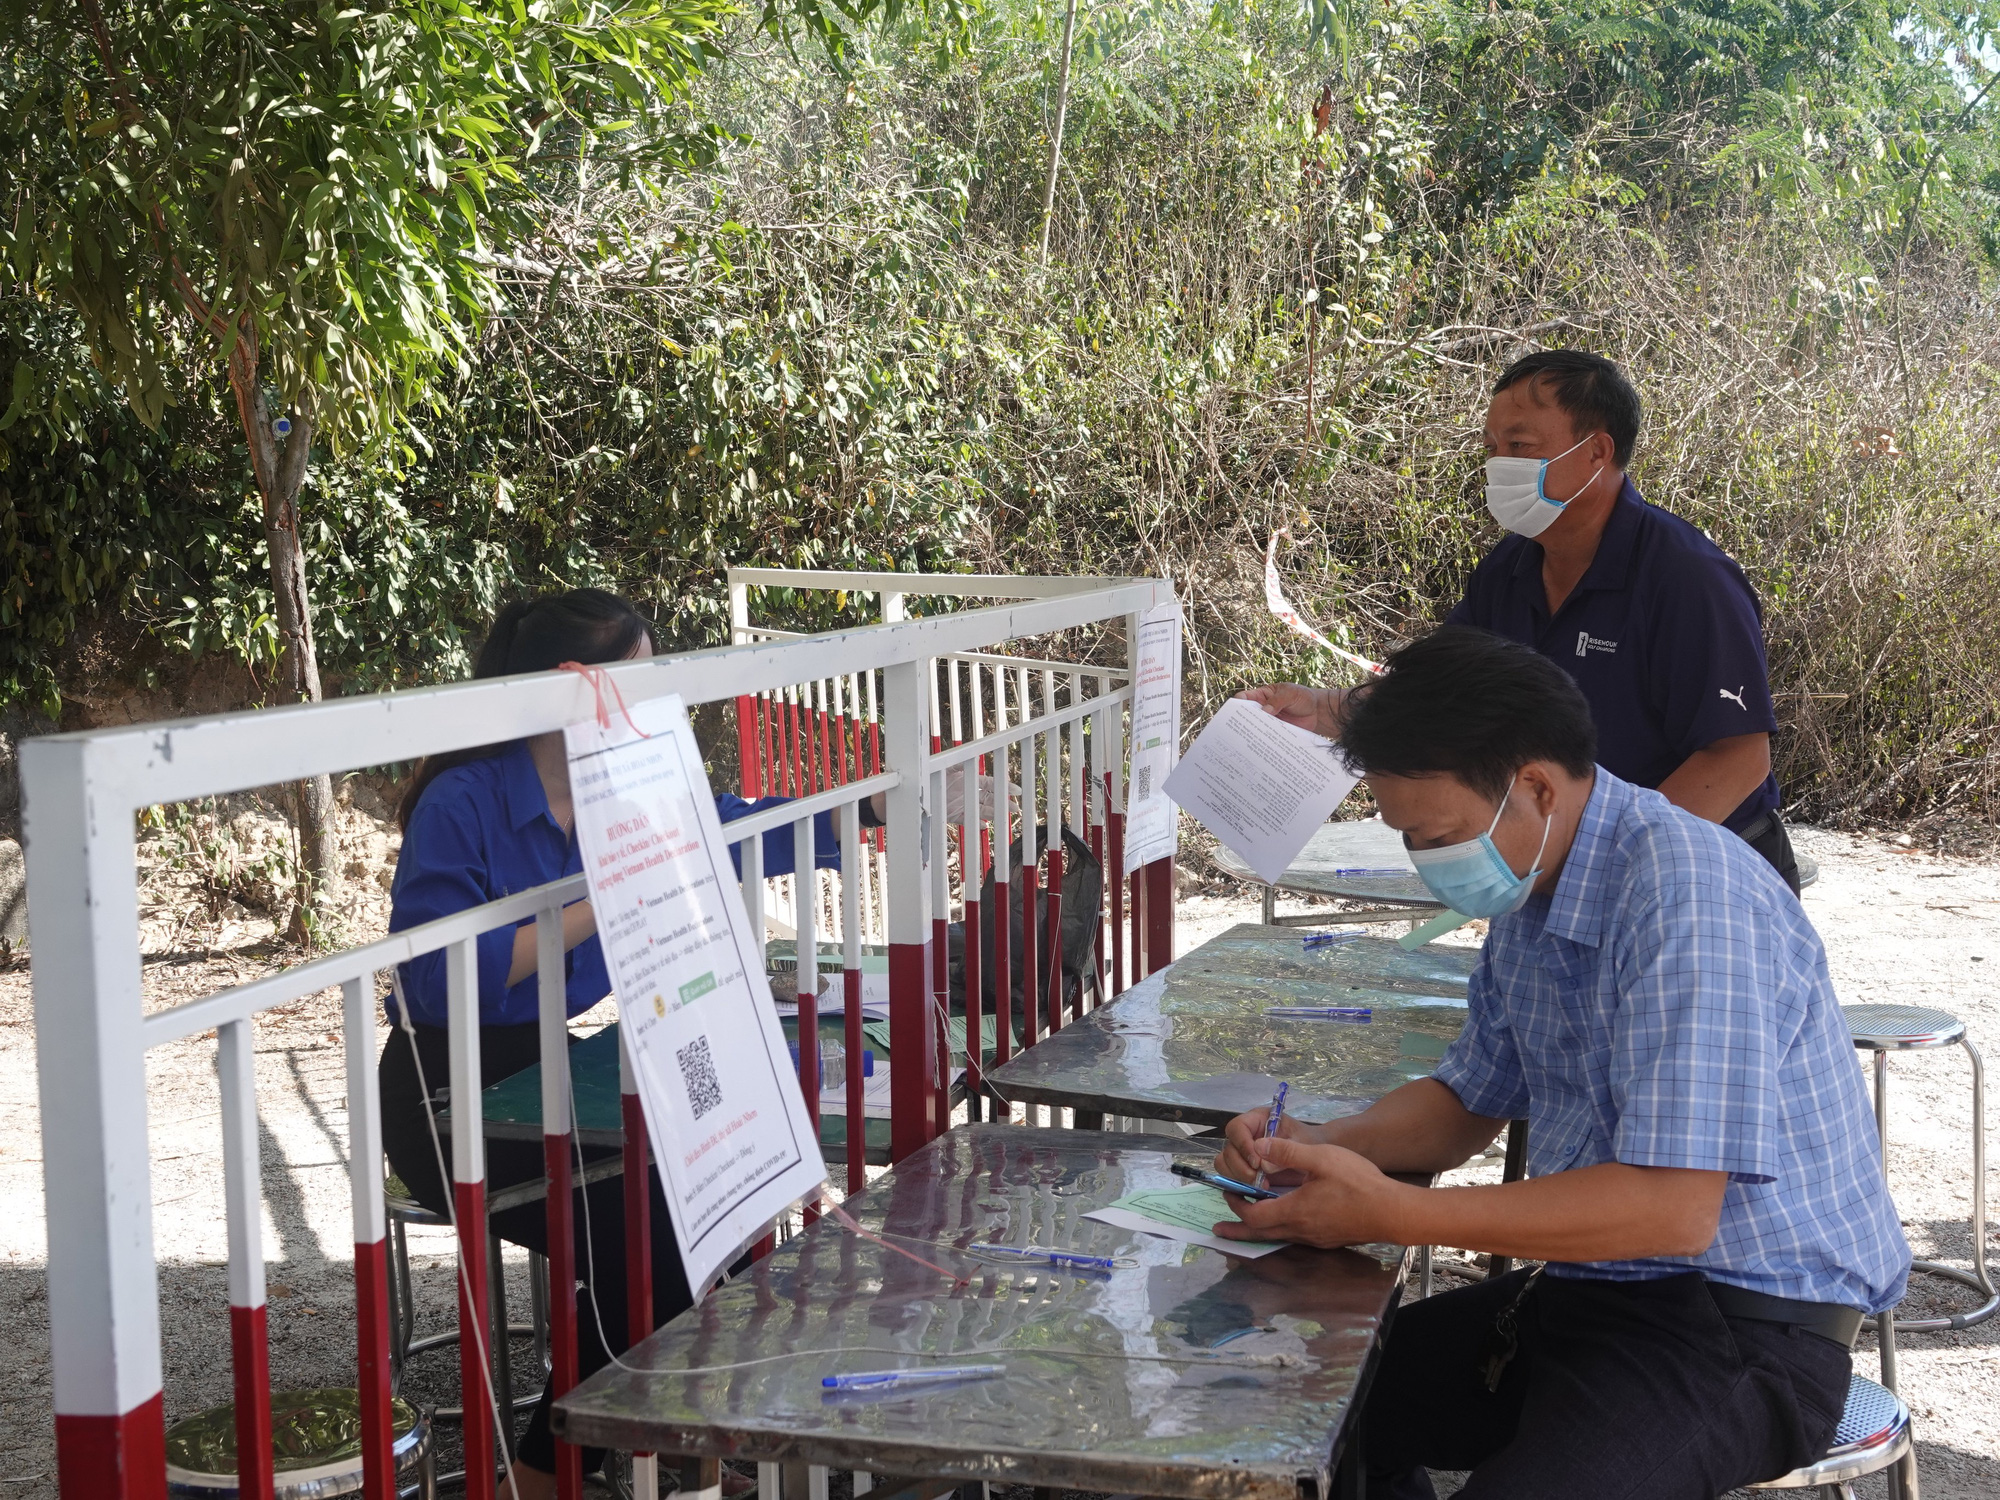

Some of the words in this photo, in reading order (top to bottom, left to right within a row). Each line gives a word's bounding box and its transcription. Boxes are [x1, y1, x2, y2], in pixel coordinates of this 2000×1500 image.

[644, 853, 664, 867] Health
[645, 896, 663, 907] Vietnam
[663, 889, 678, 900] Health
[678, 878, 705, 893] Deration
[655, 934, 673, 945] Vietnam
[672, 926, 688, 938] Health
